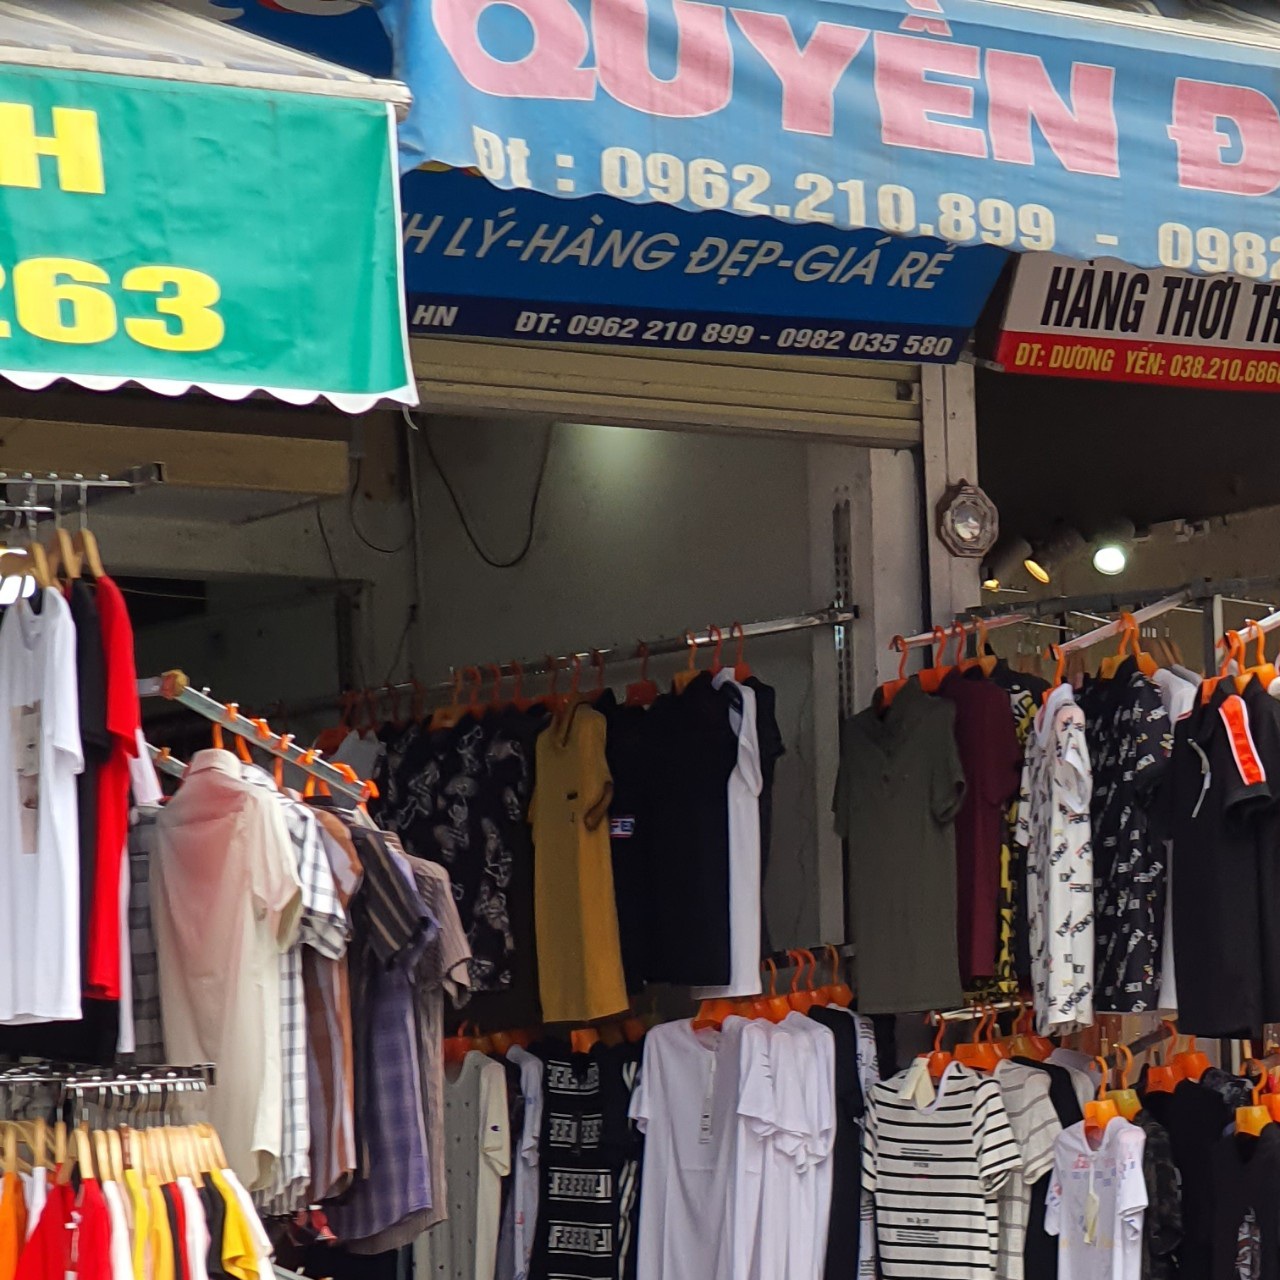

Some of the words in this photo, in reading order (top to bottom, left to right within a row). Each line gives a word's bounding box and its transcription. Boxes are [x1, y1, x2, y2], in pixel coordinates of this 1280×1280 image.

[602, 147, 1055, 250] 0962.210.899
[0, 256, 225, 352] 63
[411, 304, 459, 328] HN
[567, 314, 640, 339] 0962
[642, 319, 697, 342] 210
[702, 322, 754, 345] 899
[777, 327, 846, 350] 0982
[849, 331, 900, 353] 035
[903, 335, 954, 357] 580
